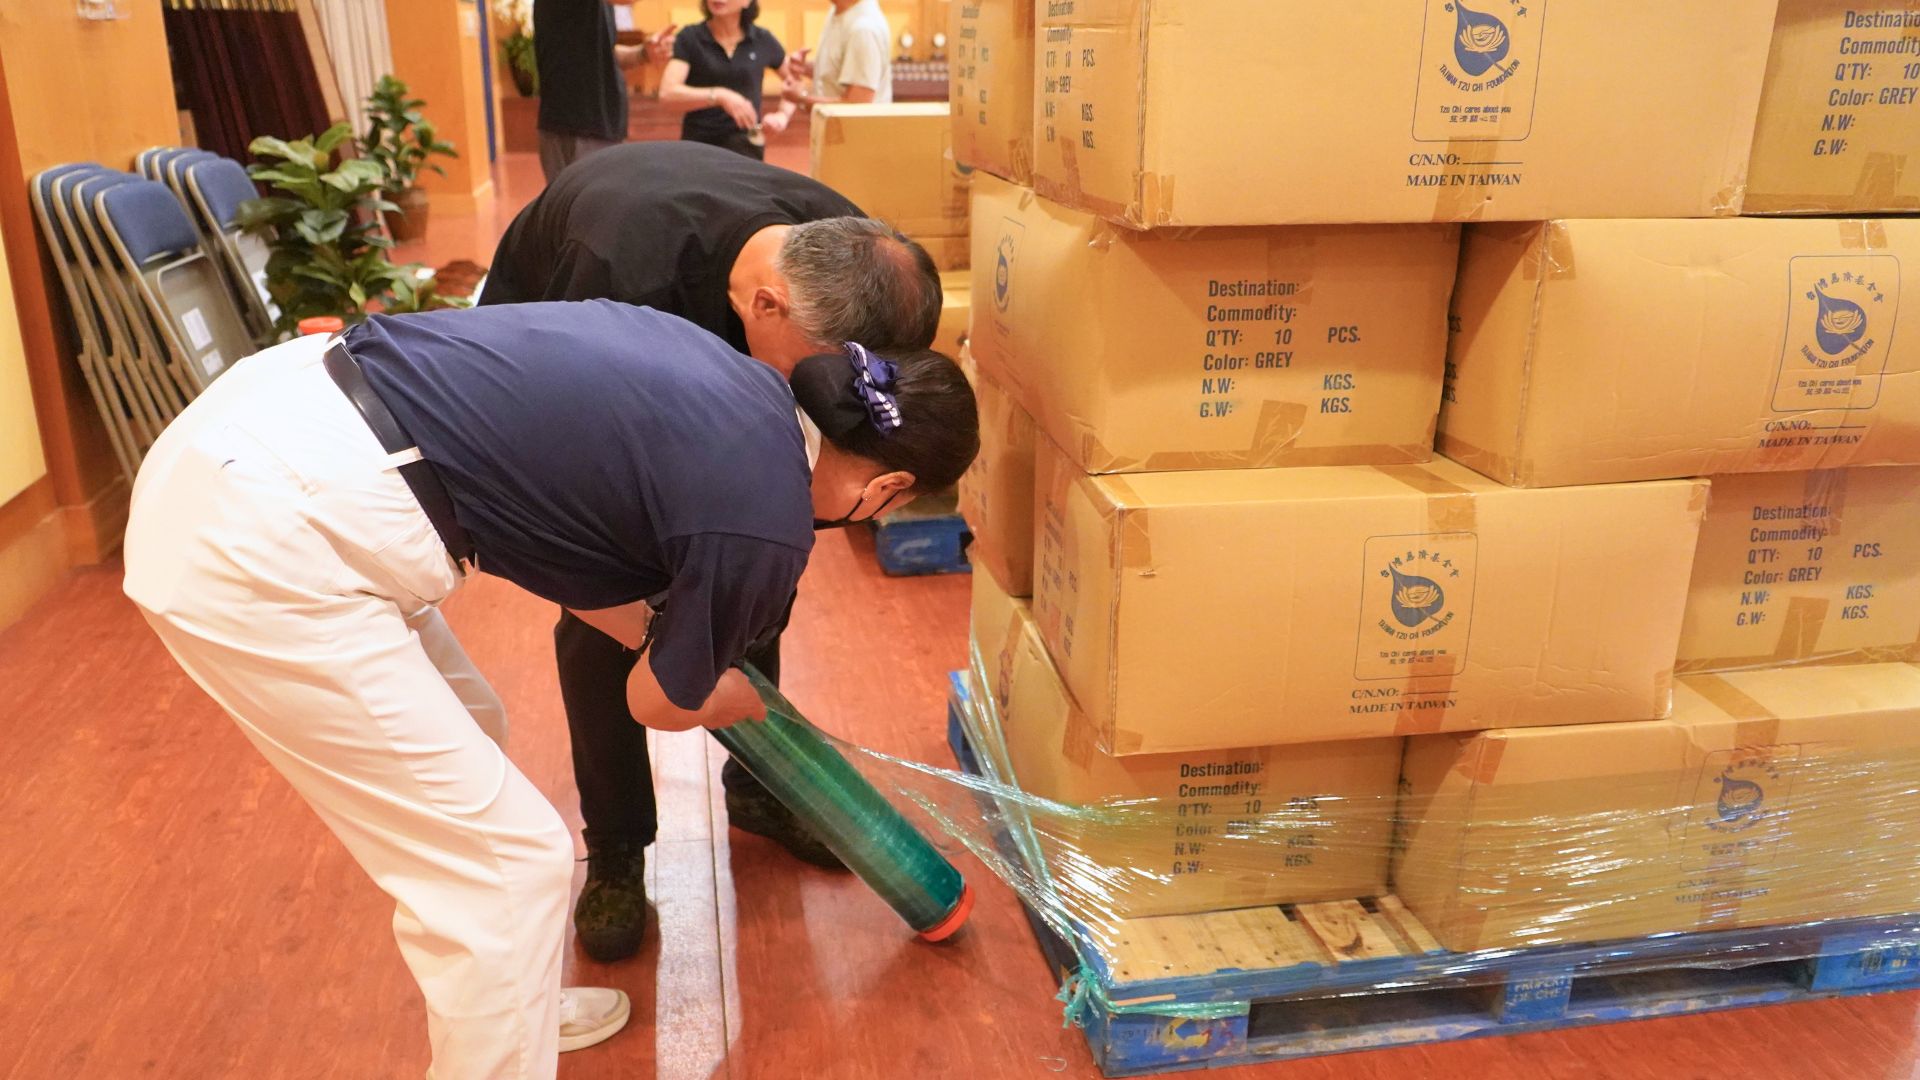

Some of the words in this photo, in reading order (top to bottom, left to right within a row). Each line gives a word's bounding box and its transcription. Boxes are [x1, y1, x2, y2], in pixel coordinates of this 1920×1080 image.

[1835, 63, 1872, 81] Q'TY:
[1903, 62, 1920, 80] 10
[1458, 81, 1471, 92] TZU
[1828, 88, 1874, 107] Color:
[1879, 87, 1918, 105] GREY
[1821, 114, 1856, 132] N.W:
[1813, 139, 1848, 156] G.W:
[1409, 153, 1461, 167] C/N.NO:
[1406, 174, 1447, 187] MADE
[1450, 174, 1465, 186] IN
[1469, 173, 1521, 186] TAIWAN
[1208, 279, 1300, 297] Destination:
[1207, 304, 1297, 323] Commodity:
[1206, 329, 1243, 347] Q'TY:
[1274, 328, 1292, 345] 10
[1327, 326, 1361, 343] PCS.
[1203, 353, 1249, 371] Color:
[1255, 351, 1293, 369] GREY
[1202, 378, 1235, 395] N.W:
[1323, 374, 1356, 391] KGS.
[1200, 401, 1233, 418] G.W:
[1320, 397, 1352, 414] KGS.
[1758, 435, 1794, 449] MADE
[1798, 435, 1812, 446] IN
[1815, 434, 1863, 446] TAIWAN
[1753, 504, 1831, 521] Destination:
[1750, 525, 1828, 543] Commodity:
[1748, 548, 1780, 564] Q'TY:
[1807, 547, 1823, 561] 10
[1853, 543, 1883, 558] PCS.
[1744, 570, 1783, 585] Color:
[1788, 567, 1822, 582] GREY
[1741, 591, 1770, 606] N.W:
[1846, 585, 1874, 600] KGS.
[1736, 612, 1766, 626] G.W:
[1842, 605, 1870, 619] KGS.
[1349, 702, 1388, 714] MADE
[1390, 700, 1404, 711] IN
[1406, 699, 1457, 710] TAIWAN
[1180, 760, 1264, 778] Destination:
[1179, 781, 1262, 798] Commodity:
[1245, 799, 1262, 814] 10
